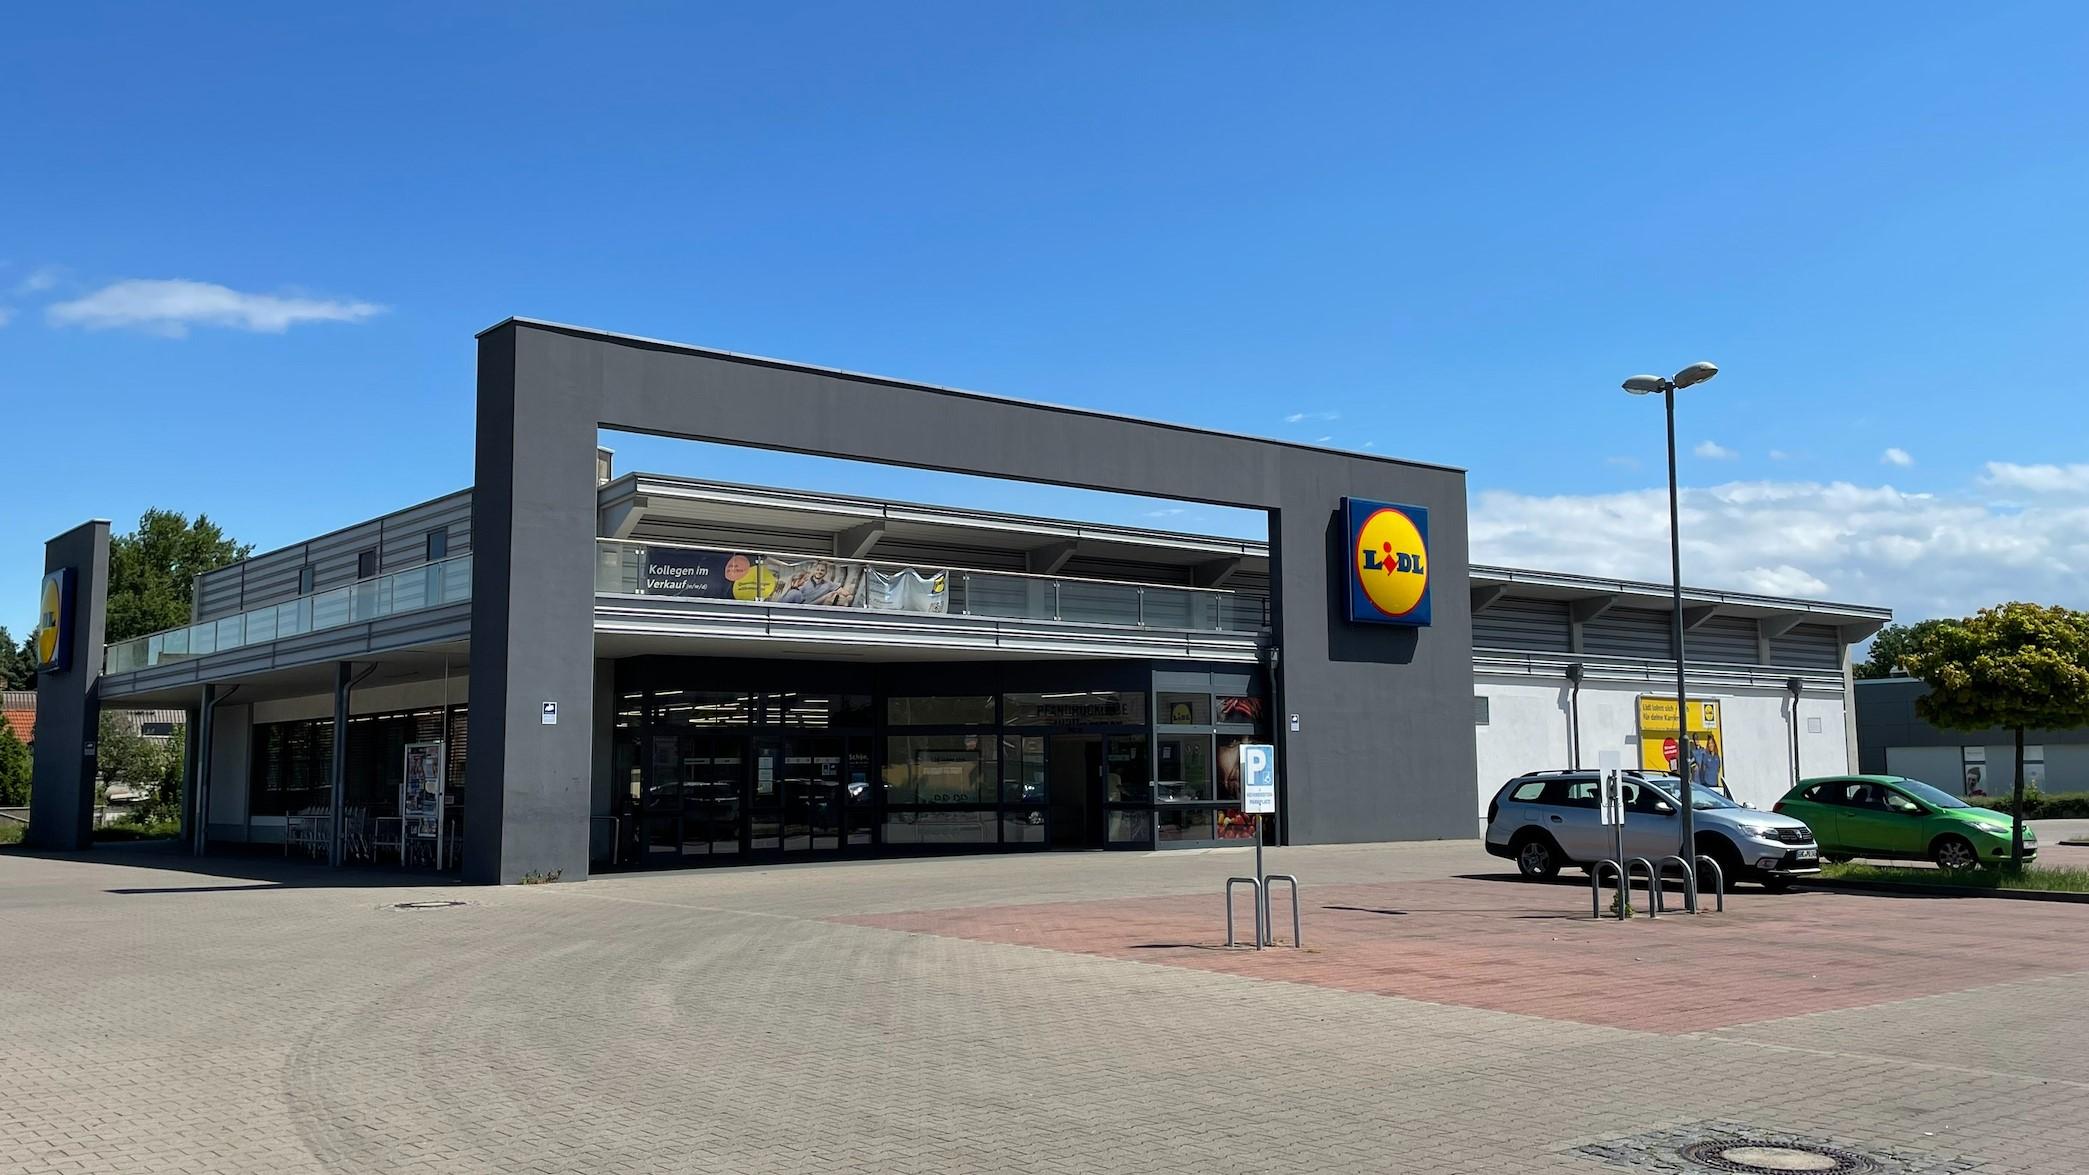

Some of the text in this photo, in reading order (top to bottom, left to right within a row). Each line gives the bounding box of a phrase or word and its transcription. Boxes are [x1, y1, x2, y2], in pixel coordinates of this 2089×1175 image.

[1363, 541, 1424, 576] LIDL
[649, 564, 709, 578] Kollegen im
[646, 578, 687, 589] Verkauf
[1248, 748, 1267, 785] P
